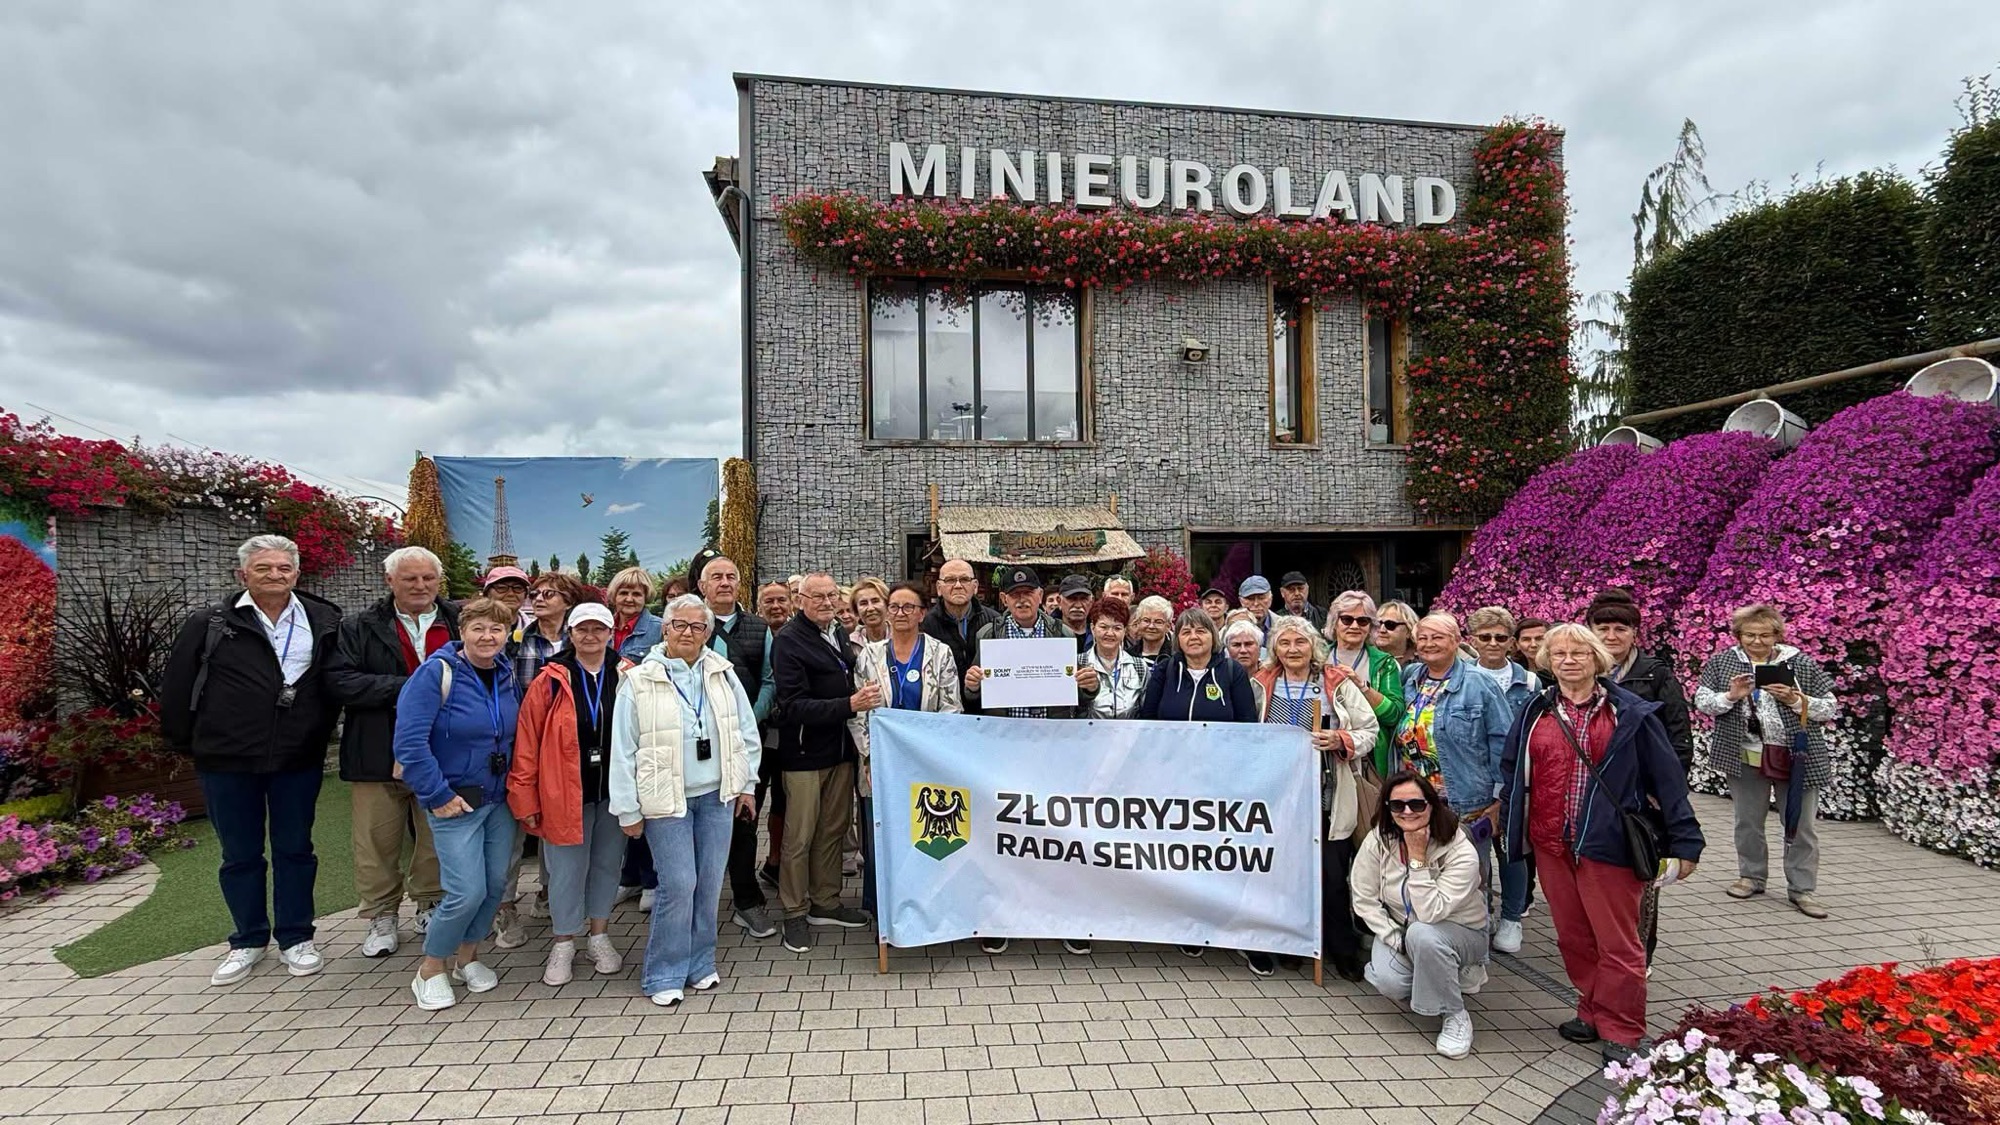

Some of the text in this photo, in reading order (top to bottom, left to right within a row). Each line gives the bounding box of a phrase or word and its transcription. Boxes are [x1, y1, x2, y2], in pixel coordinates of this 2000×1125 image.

[889, 141, 1457, 227] MINIEUROLAND
[1020, 533, 1095, 549] INFORMACJA
[996, 792, 1274, 834] ZŁOTORYJSKA
[996, 833, 1275, 873] RADA SENIORÓW
